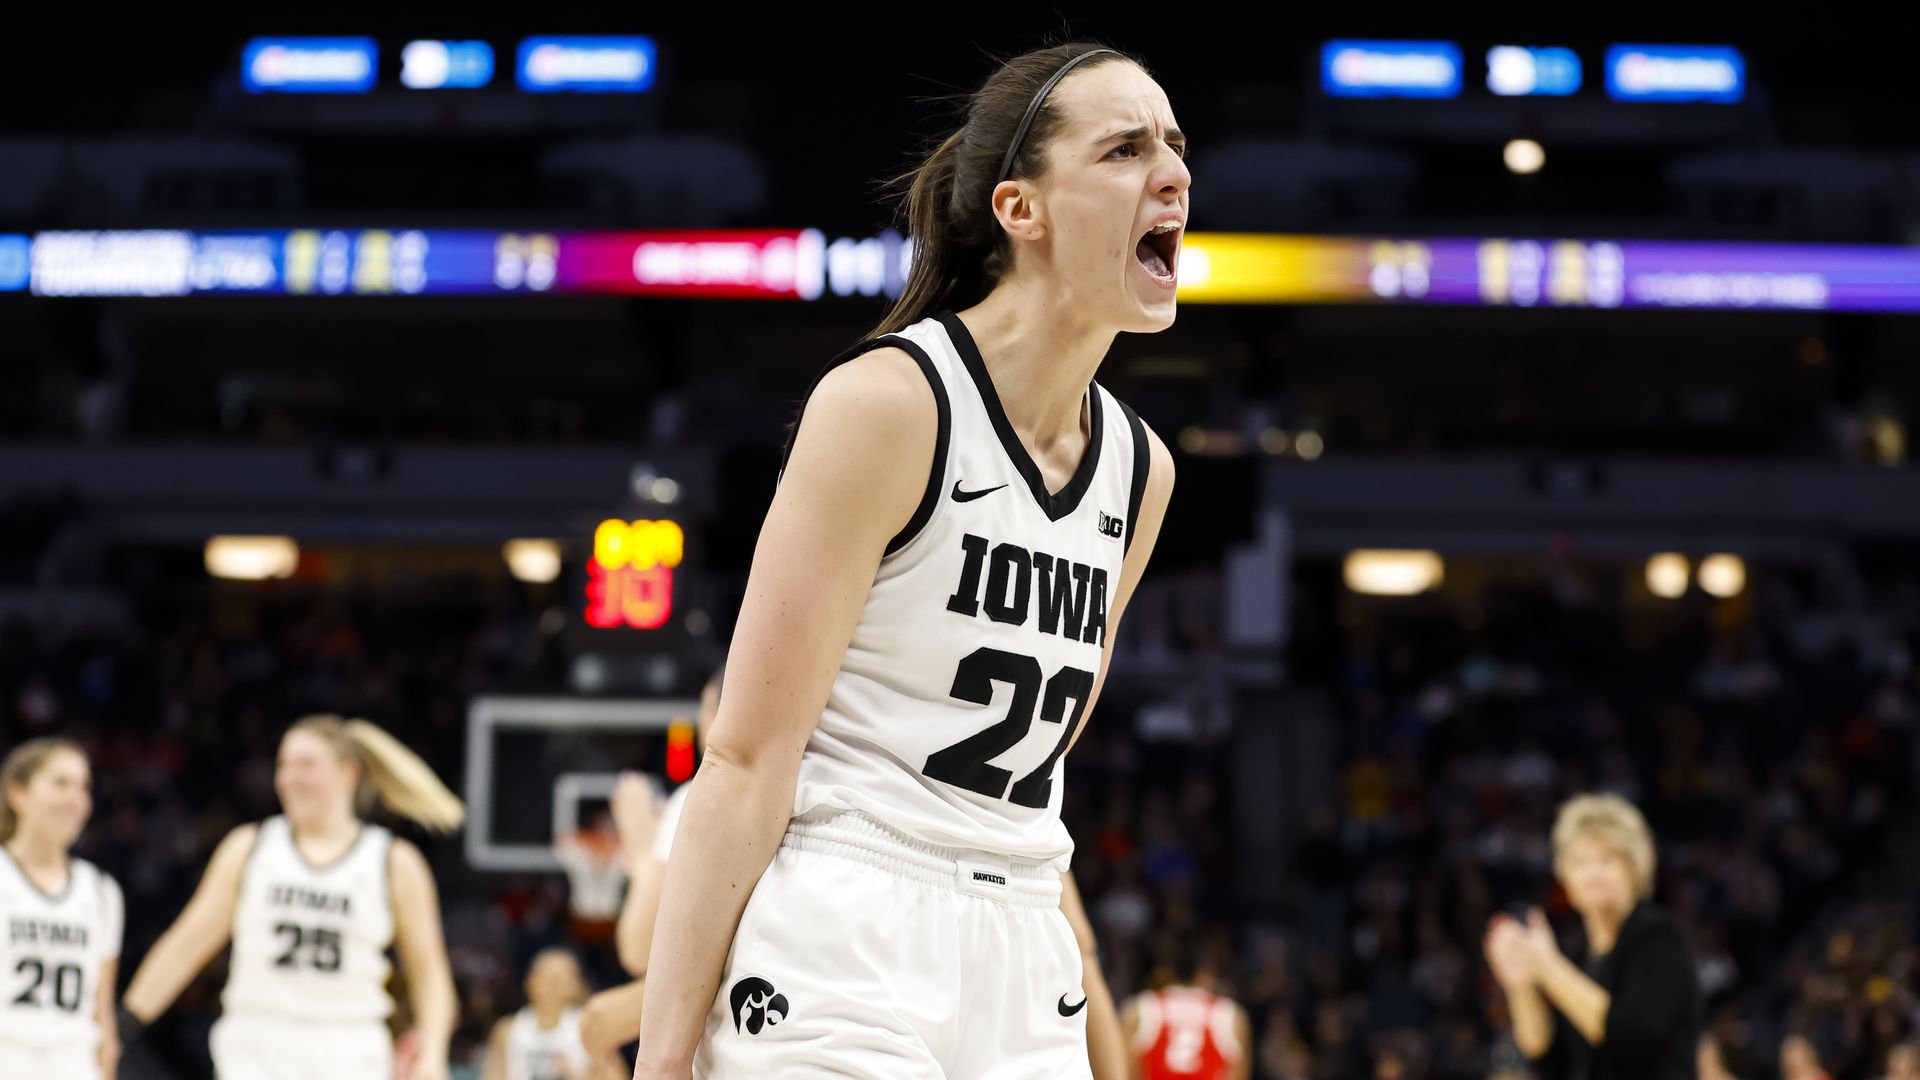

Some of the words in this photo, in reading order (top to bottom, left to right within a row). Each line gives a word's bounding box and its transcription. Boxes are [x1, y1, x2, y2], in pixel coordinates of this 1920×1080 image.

[947, 533, 1107, 648] IOWA
[922, 646, 1095, 808] 22
[972, 871, 1006, 886] HAWKEYES
[273, 922, 342, 972] 25
[13, 958, 84, 1012] 20
